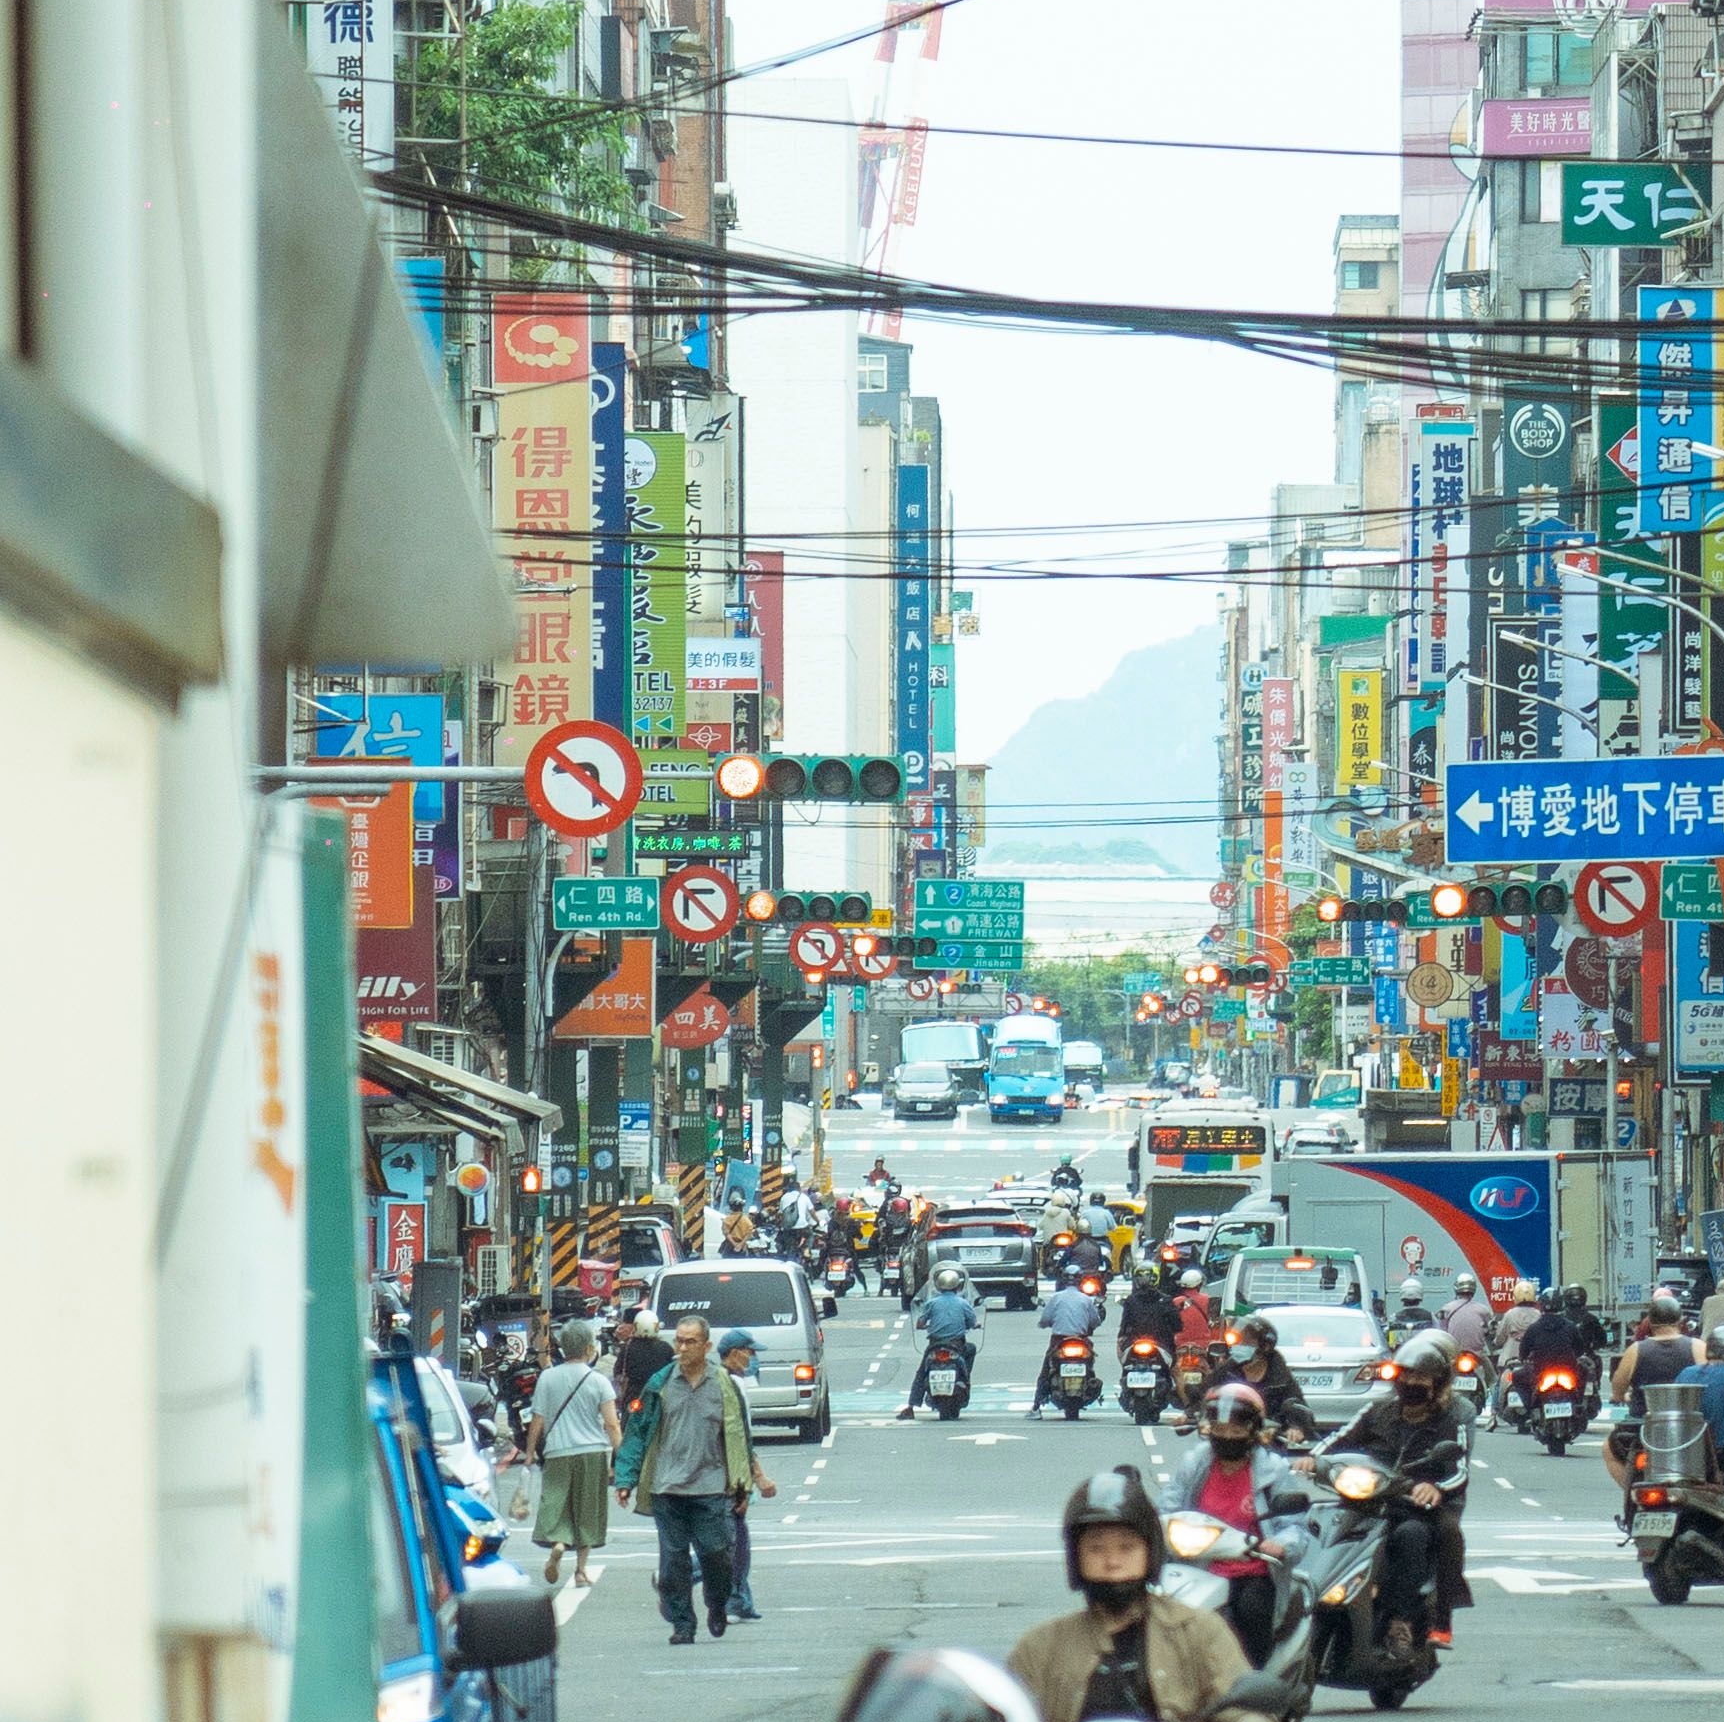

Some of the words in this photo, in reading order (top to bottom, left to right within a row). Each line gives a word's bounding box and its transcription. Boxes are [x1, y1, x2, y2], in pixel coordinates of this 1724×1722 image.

[1573, 180, 1701, 230] 天仁
[1527, 420, 1548, 429] THE
[1657, 342, 1694, 521] 傑昇通信
[1521, 429, 1555, 439] BODY
[1522, 438, 1554, 449] SHOP
[1432, 443, 1465, 540] 地球村
[511, 426, 573, 725] 得恩堂眼鏡
[688, 651, 756, 668] 美的假髮
[908, 662, 919, 729] HOTEL
[1351, 702, 1369, 780] 數位學堂
[351, 812, 369, 888] 臺灣企銀
[569, 886, 644, 904] 仁四路
[967, 885, 1021, 899] 濱海公路
[1676, 901, 1701, 913] Ren
[569, 913, 591, 922] Ren
[598, 912, 620, 922] 4th
[626, 912, 644, 922] Rd.
[966, 914, 1020, 928] 高速公路
[968, 929, 1017, 938] FREEWAY
[974, 945, 1013, 957] 金山
[1319, 961, 1363, 972] 仁二路
[388, 1006, 407, 1014] FOR
[410, 1006, 429, 1015] LIFE
[620, 1115, 631, 1128] P
[1623, 1177, 1634, 1259] 新竹物流
[773, 1313, 792, 1324] VW
